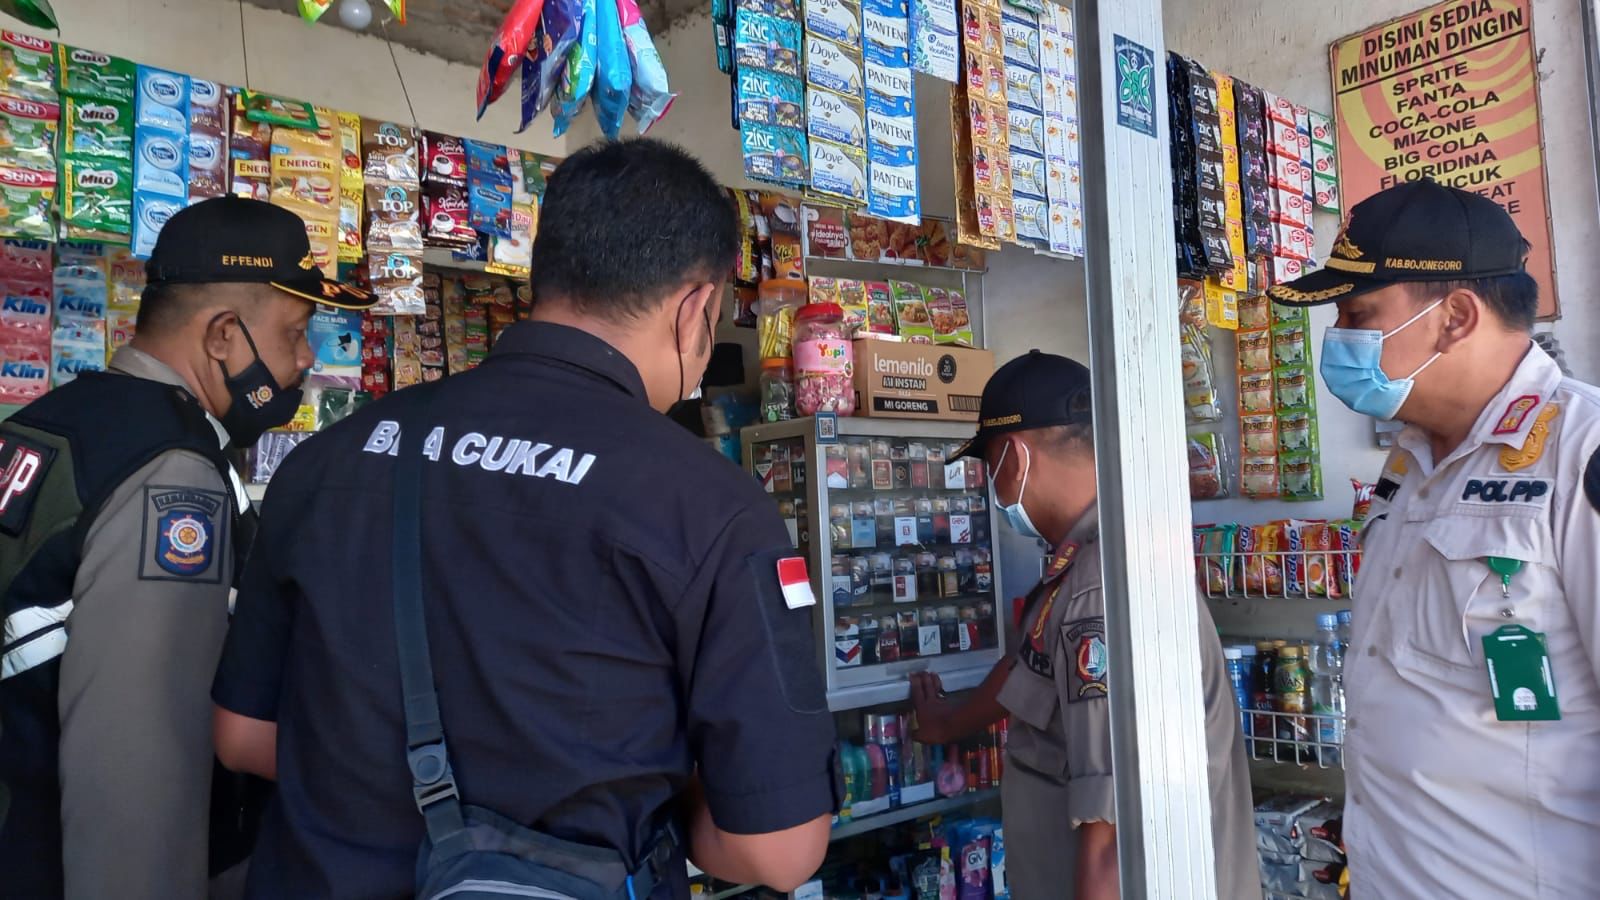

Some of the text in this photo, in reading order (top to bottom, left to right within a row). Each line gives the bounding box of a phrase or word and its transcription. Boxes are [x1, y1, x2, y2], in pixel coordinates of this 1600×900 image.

[1364, 0, 1493, 57] DISINI SEDIA
[12, 34, 44, 48] SUN
[811, 40, 839, 60] Dove
[1342, 7, 1523, 86] MINUMAN DINGIN
[75, 53, 107, 63] MILO
[868, 68, 910, 94] PANTENE
[1393, 62, 1468, 96] SPRITE
[812, 92, 841, 113] Dove
[1397, 82, 1466, 113] FANTA
[7, 101, 39, 115] SUN
[82, 110, 115, 120] MILO
[1369, 91, 1500, 138] COCA-COLA
[374, 133, 407, 147] TOP
[871, 119, 912, 141] PANTENE
[1393, 116, 1476, 151] MIZONE
[814, 144, 843, 164] Dove
[1384, 132, 1489, 171] BIG COLA
[280, 158, 330, 169] ENERGEN
[1380, 149, 1497, 190] FLORIDINA
[80, 174, 115, 186] MILO
[874, 169, 913, 190] PANTENE
[378, 199, 414, 213] TOP
[222, 255, 273, 268] EFFENDI
[1385, 257, 1462, 272] KAB.BOJONEGORO
[3, 295, 47, 315] Klin
[59, 295, 102, 314] Klin
[818, 343, 845, 358] Yupi
[1, 360, 45, 380] Klin
[874, 353, 933, 376] lemonilo
[895, 377, 926, 389] INSTAN
[884, 400, 928, 411] MI GORENG
[363, 420, 597, 485] BA CUKAI
